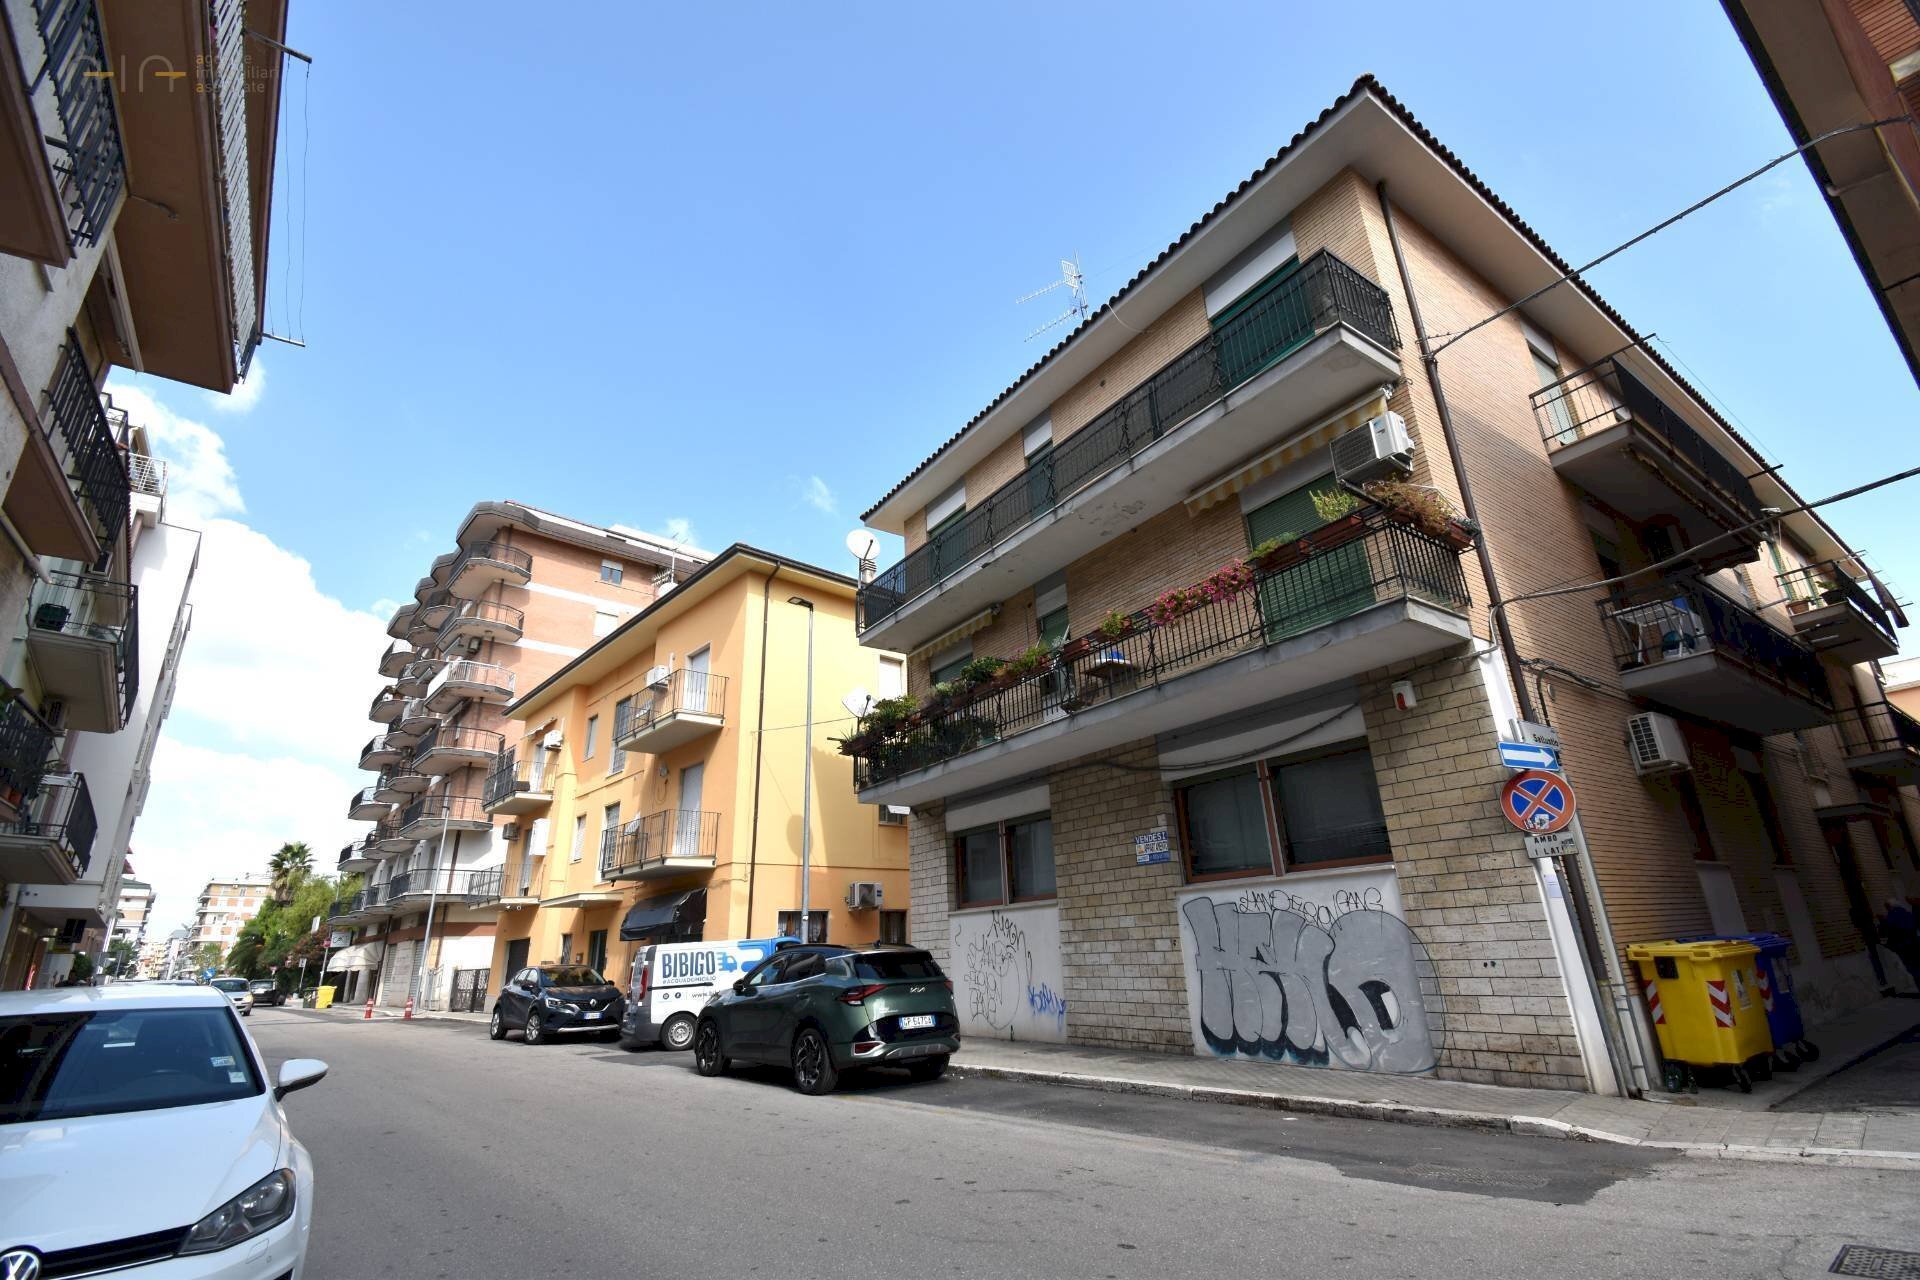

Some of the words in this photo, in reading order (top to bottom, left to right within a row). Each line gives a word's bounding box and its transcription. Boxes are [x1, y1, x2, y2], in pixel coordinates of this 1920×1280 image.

[1135, 832, 1166, 844] VENDESI
[1534, 834, 1558, 844] AMBO
[662, 951, 716, 978] BIBIGO
